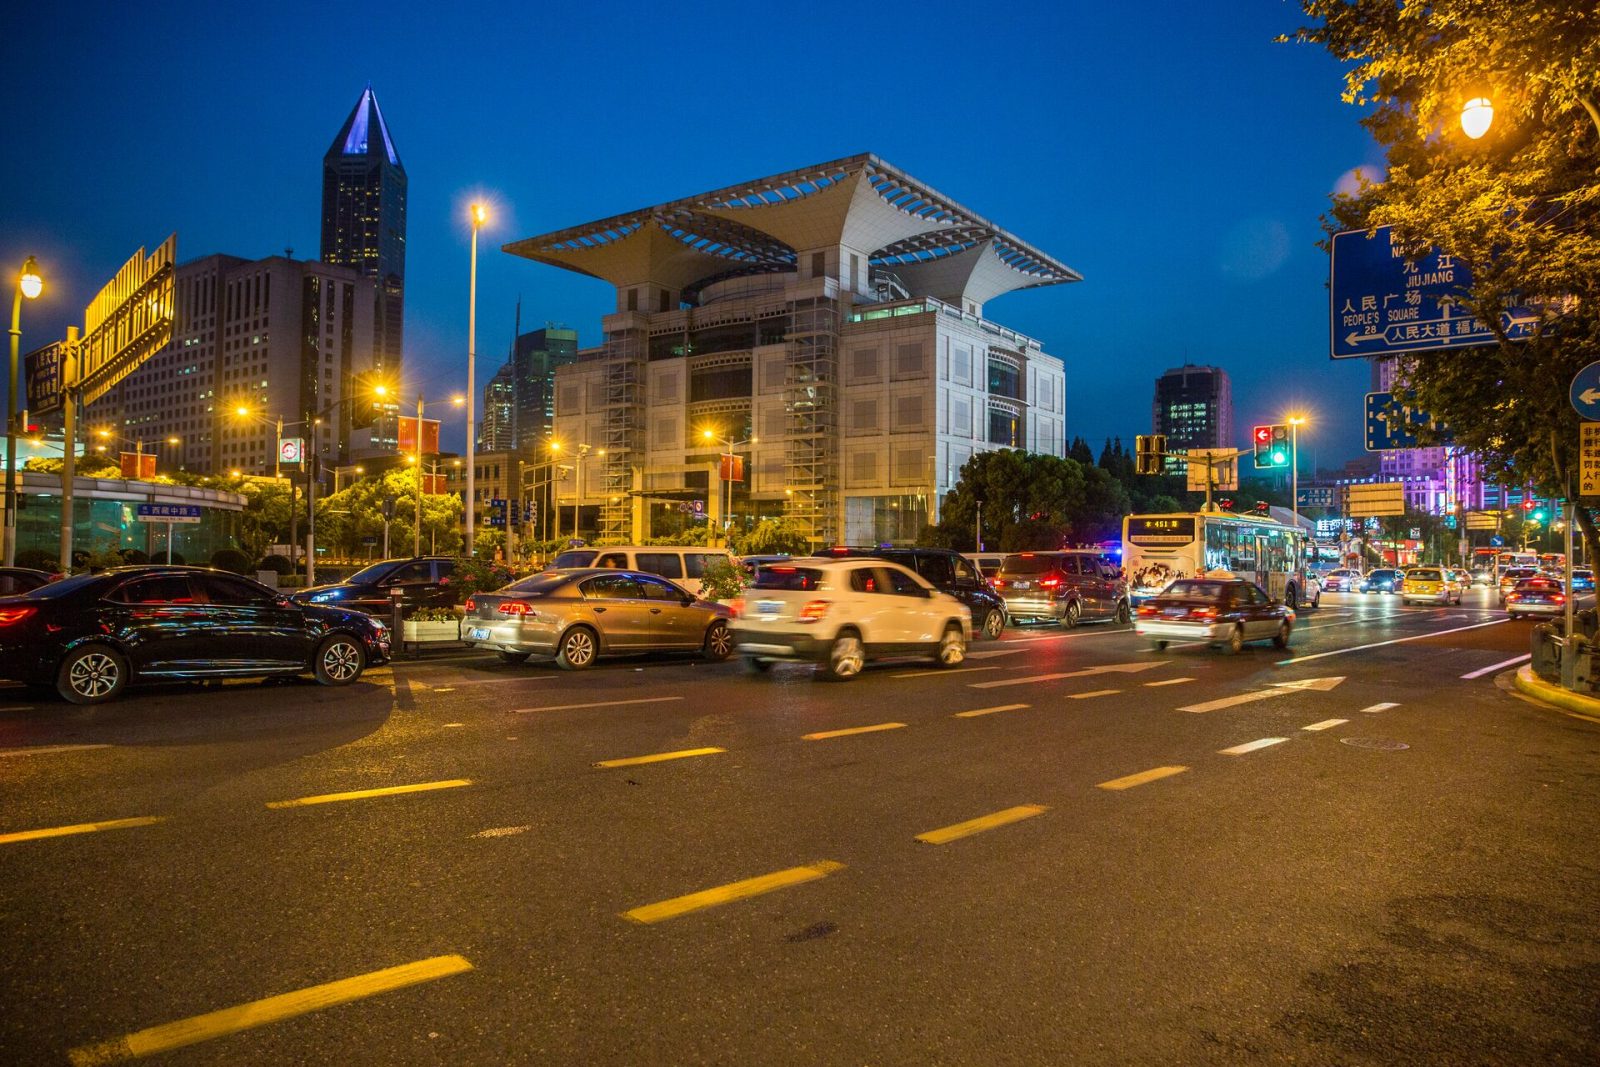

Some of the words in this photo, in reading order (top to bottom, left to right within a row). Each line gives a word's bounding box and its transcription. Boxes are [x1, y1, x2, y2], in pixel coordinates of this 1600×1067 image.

[1402, 253, 1455, 274] 九江
[1405, 270, 1455, 288] JIUJIANG
[1340, 289, 1422, 314] 人民广场
[1343, 312, 1380, 327] PEOPLE'S
[1387, 307, 1420, 322] SQUARE
[1364, 325, 1377, 335] 28
[1392, 322, 1451, 341] 人民大道
